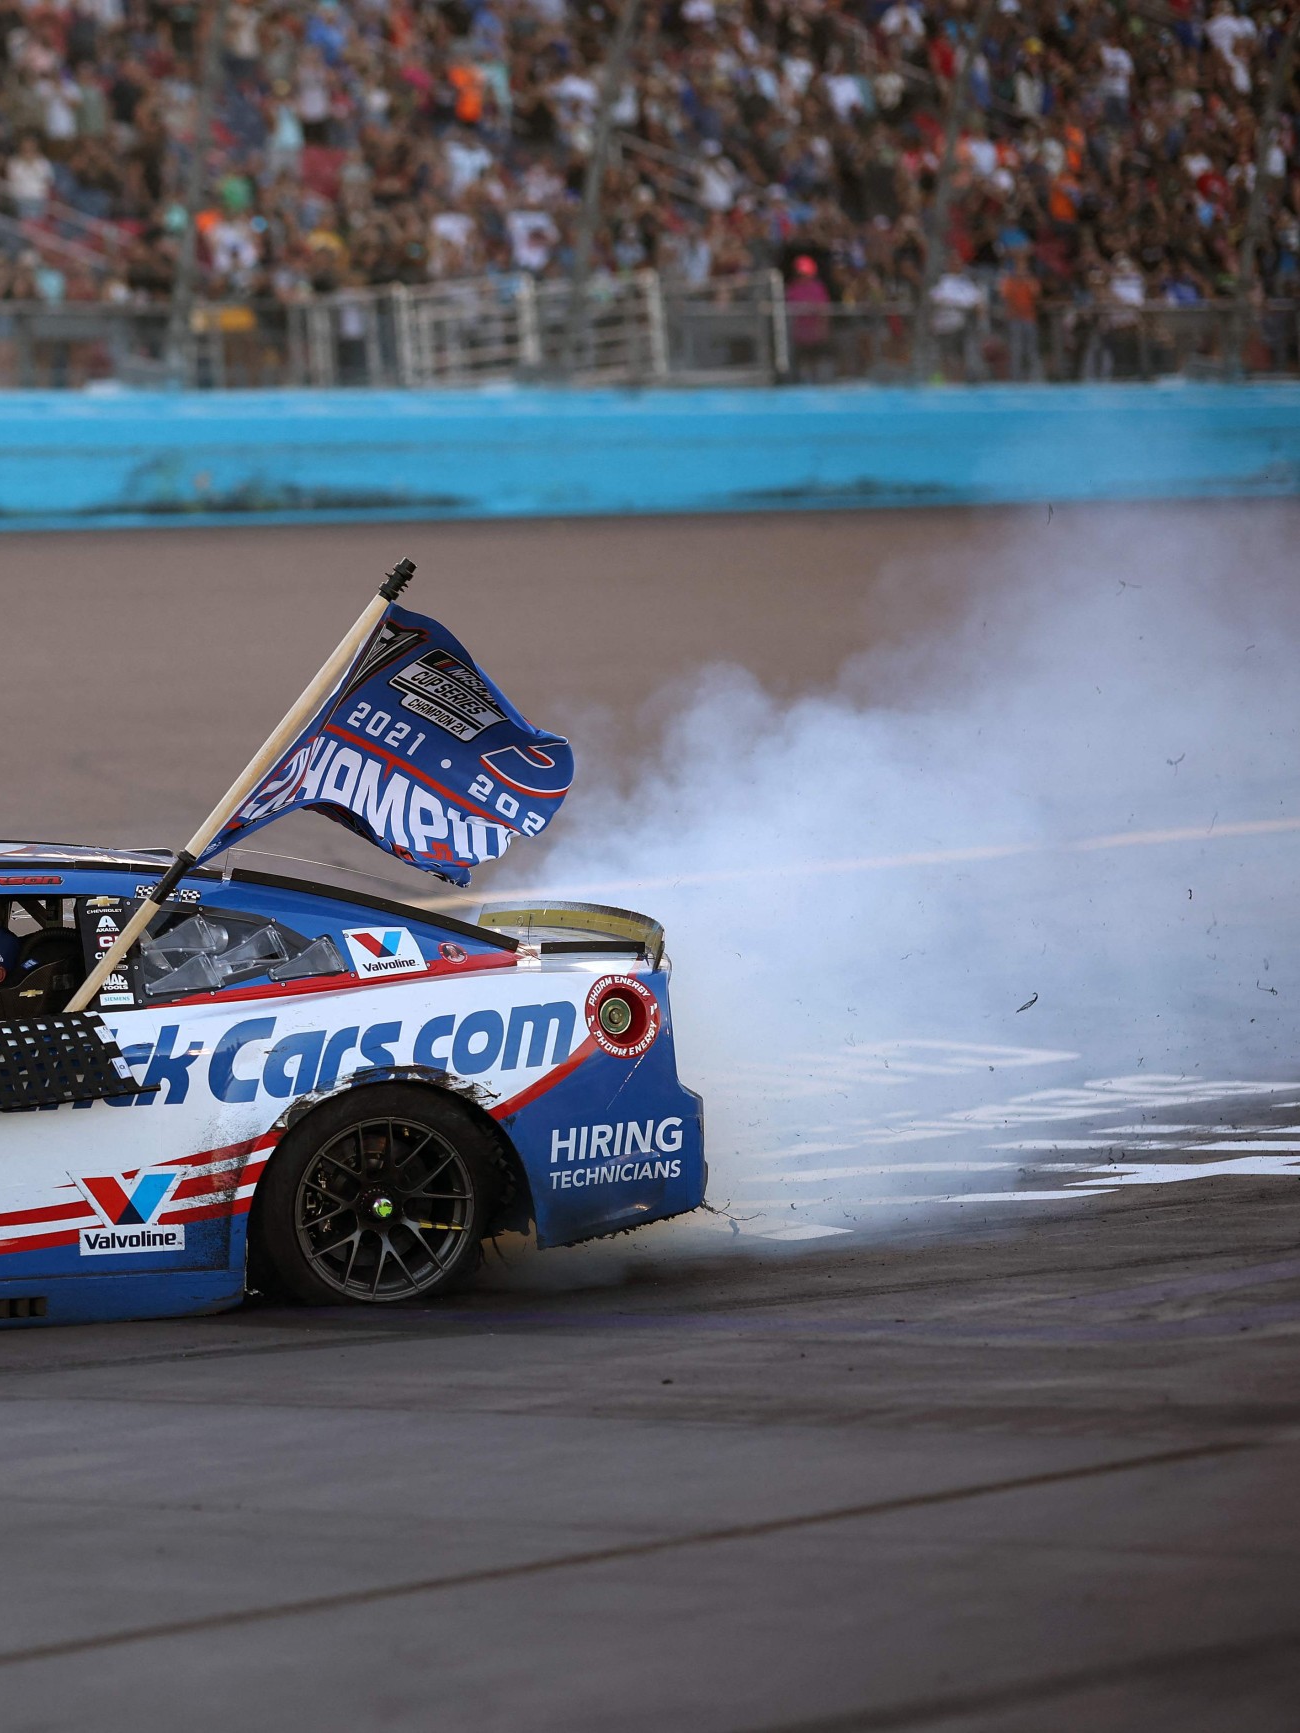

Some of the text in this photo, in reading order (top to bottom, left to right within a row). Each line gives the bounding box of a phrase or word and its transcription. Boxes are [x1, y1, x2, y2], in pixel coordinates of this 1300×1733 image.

[411, 671, 488, 716] CUP SERIES
[347, 701, 426, 756] 2021
[407, 698, 470, 736] CHAMPION 2X
[467, 774, 546, 837] 202
[362, 958, 417, 972] Valvoline
[614, 976, 651, 997] ENERGY
[628, 1020, 657, 1055] ENERGY
[550, 1117, 684, 1163] HIRING
[550, 1159, 682, 1190] TECHNICIANS
[84, 1230, 177, 1250] Valvoline
